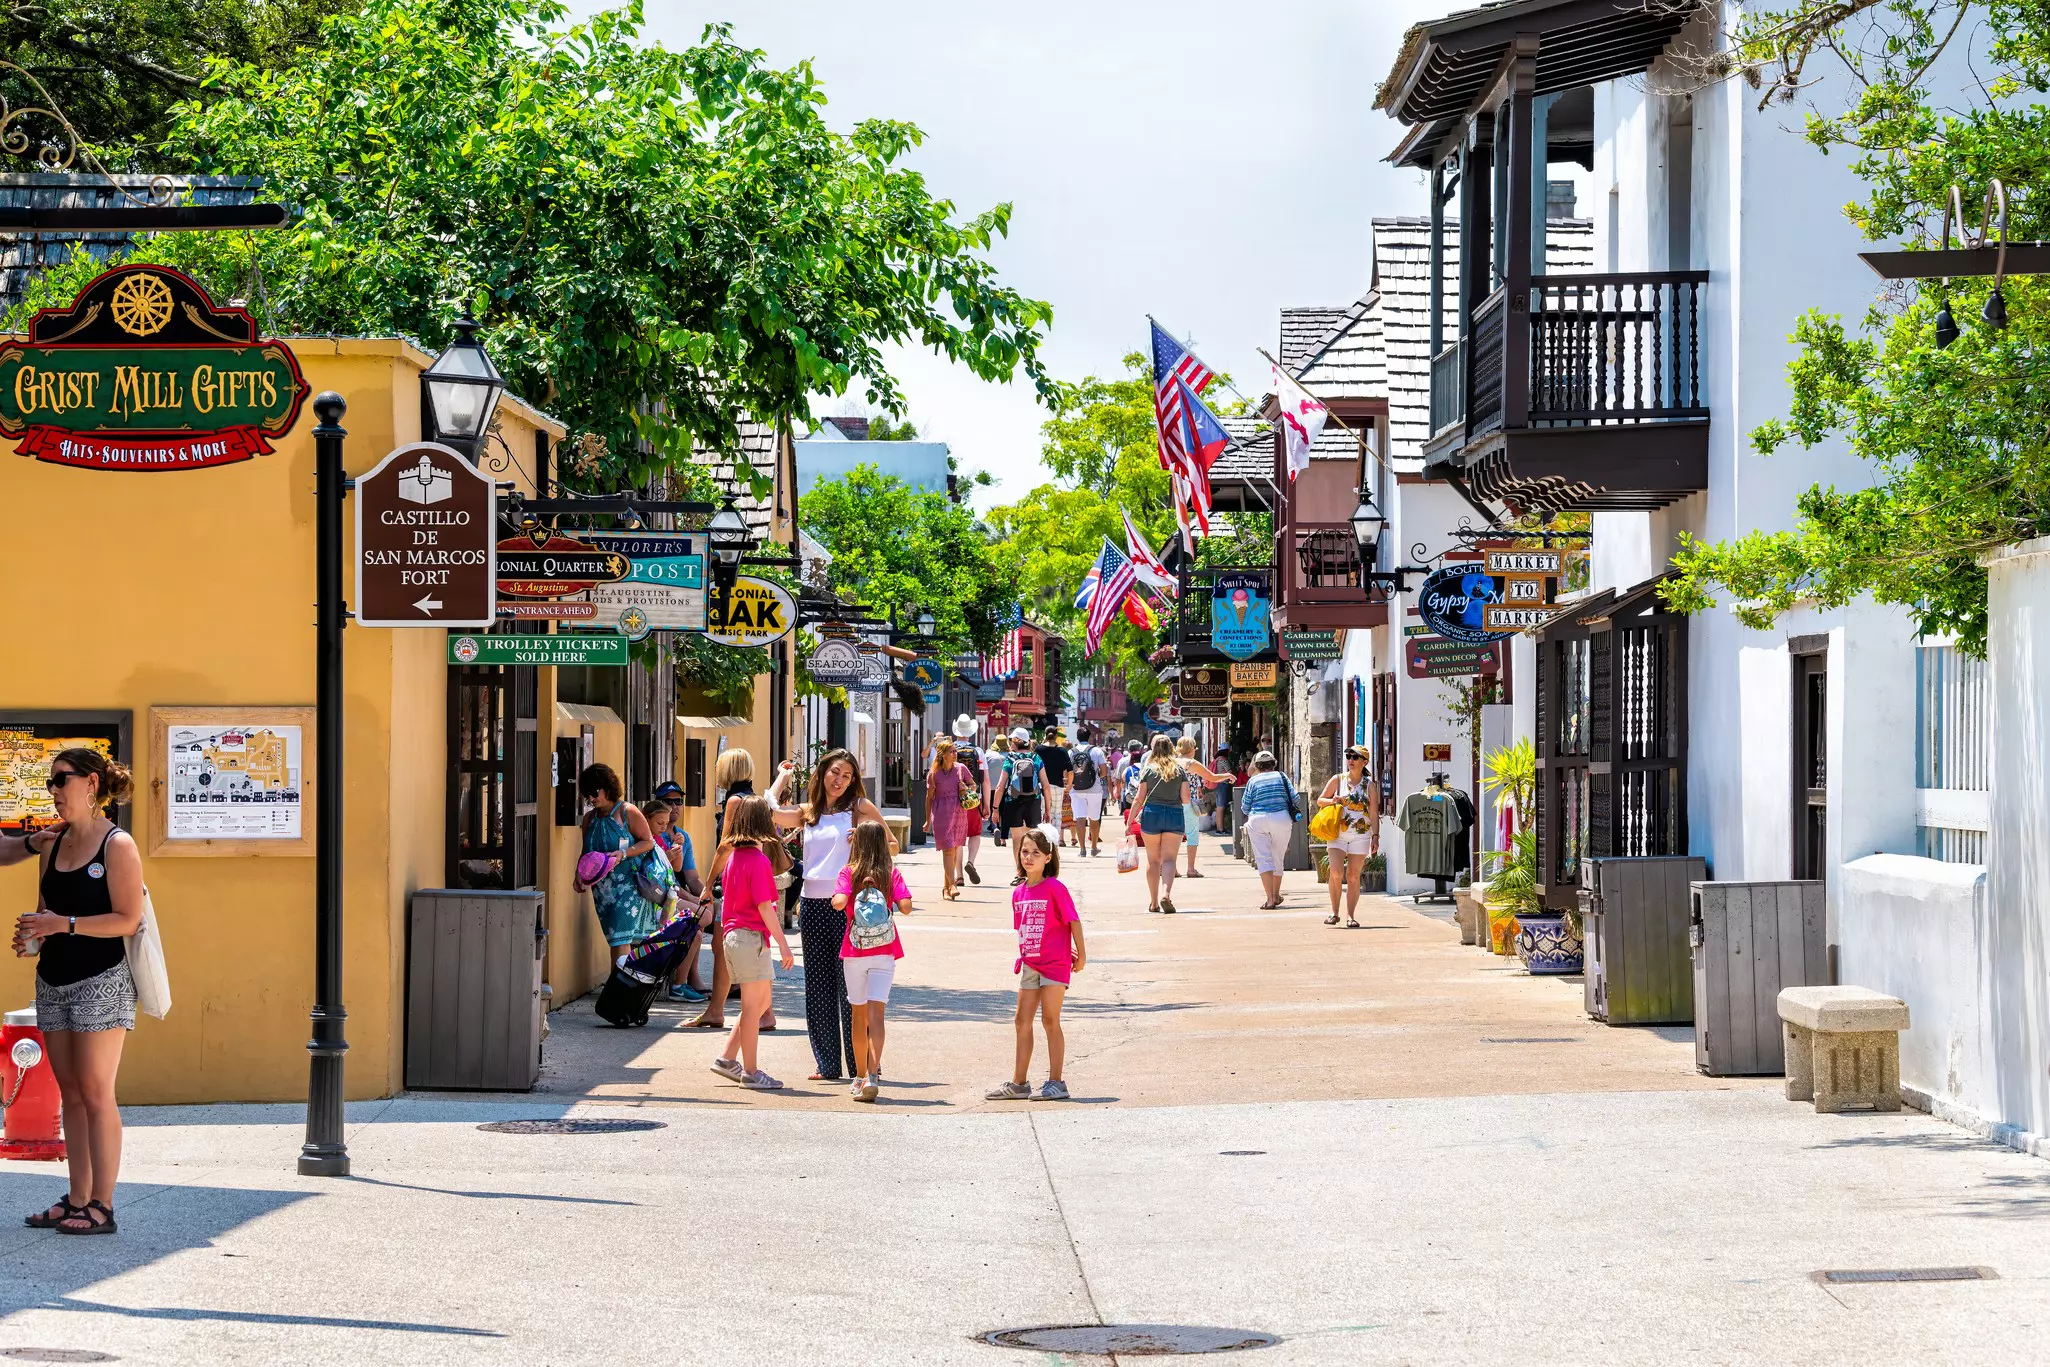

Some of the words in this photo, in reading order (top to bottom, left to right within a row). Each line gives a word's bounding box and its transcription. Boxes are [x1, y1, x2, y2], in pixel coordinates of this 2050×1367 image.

[15, 365, 100, 414] GRIST
[108, 365, 184, 423] MILL
[191, 364, 278, 414] GIFTS
[101, 446, 175, 464] SOUVENIRS
[178, 448, 189, 462] &
[190, 440, 229, 462] MORE
[380, 510, 470, 525] CASTILLO
[412, 530, 438, 545] DE
[599, 541, 683, 553] XPLORER'S
[364, 550, 402, 565] SAN
[406, 550, 486, 565] MARCOS
[1493, 556, 1557, 568] MARKET
[496, 561, 539, 572] LONIAL
[543, 558, 604, 577] QUARTER
[631, 563, 698, 579] POST
[400, 570, 450, 585] FORT
[509, 582, 523, 593] St.
[525, 582, 569, 594] Augustine
[1222, 580, 1242, 589] SWEET
[1244, 579, 1260, 588] SPOT
[612, 589, 672, 597] AUGUSTINE
[710, 588, 776, 599] CLONIAL
[1514, 584, 1534, 596] TO
[577, 596, 612, 604] GODS
[627, 598, 690, 606] PROVISIONS
[1428, 591, 1470, 614] Gypsy
[515, 606, 560, 615] ENTRANCE
[562, 606, 592, 615] AHEAD
[1410, 626, 1428, 634] THE
[1432, 616, 1467, 636] ORGANIC
[485, 640, 553, 650] TROLLEY
[556, 640, 618, 650] TICKETS
[1424, 642, 1455, 651] GARDEN
[515, 652, 549, 662] SOLD
[552, 652, 587, 662] HERE
[1452, 653, 1477, 662] DECOR
[808, 660, 863, 668] SEAFOOD
[911, 661, 938, 669] TABERNA
[1433, 665, 1475, 674] ILLUMINART
[1236, 672, 1269, 680] BAKERY
